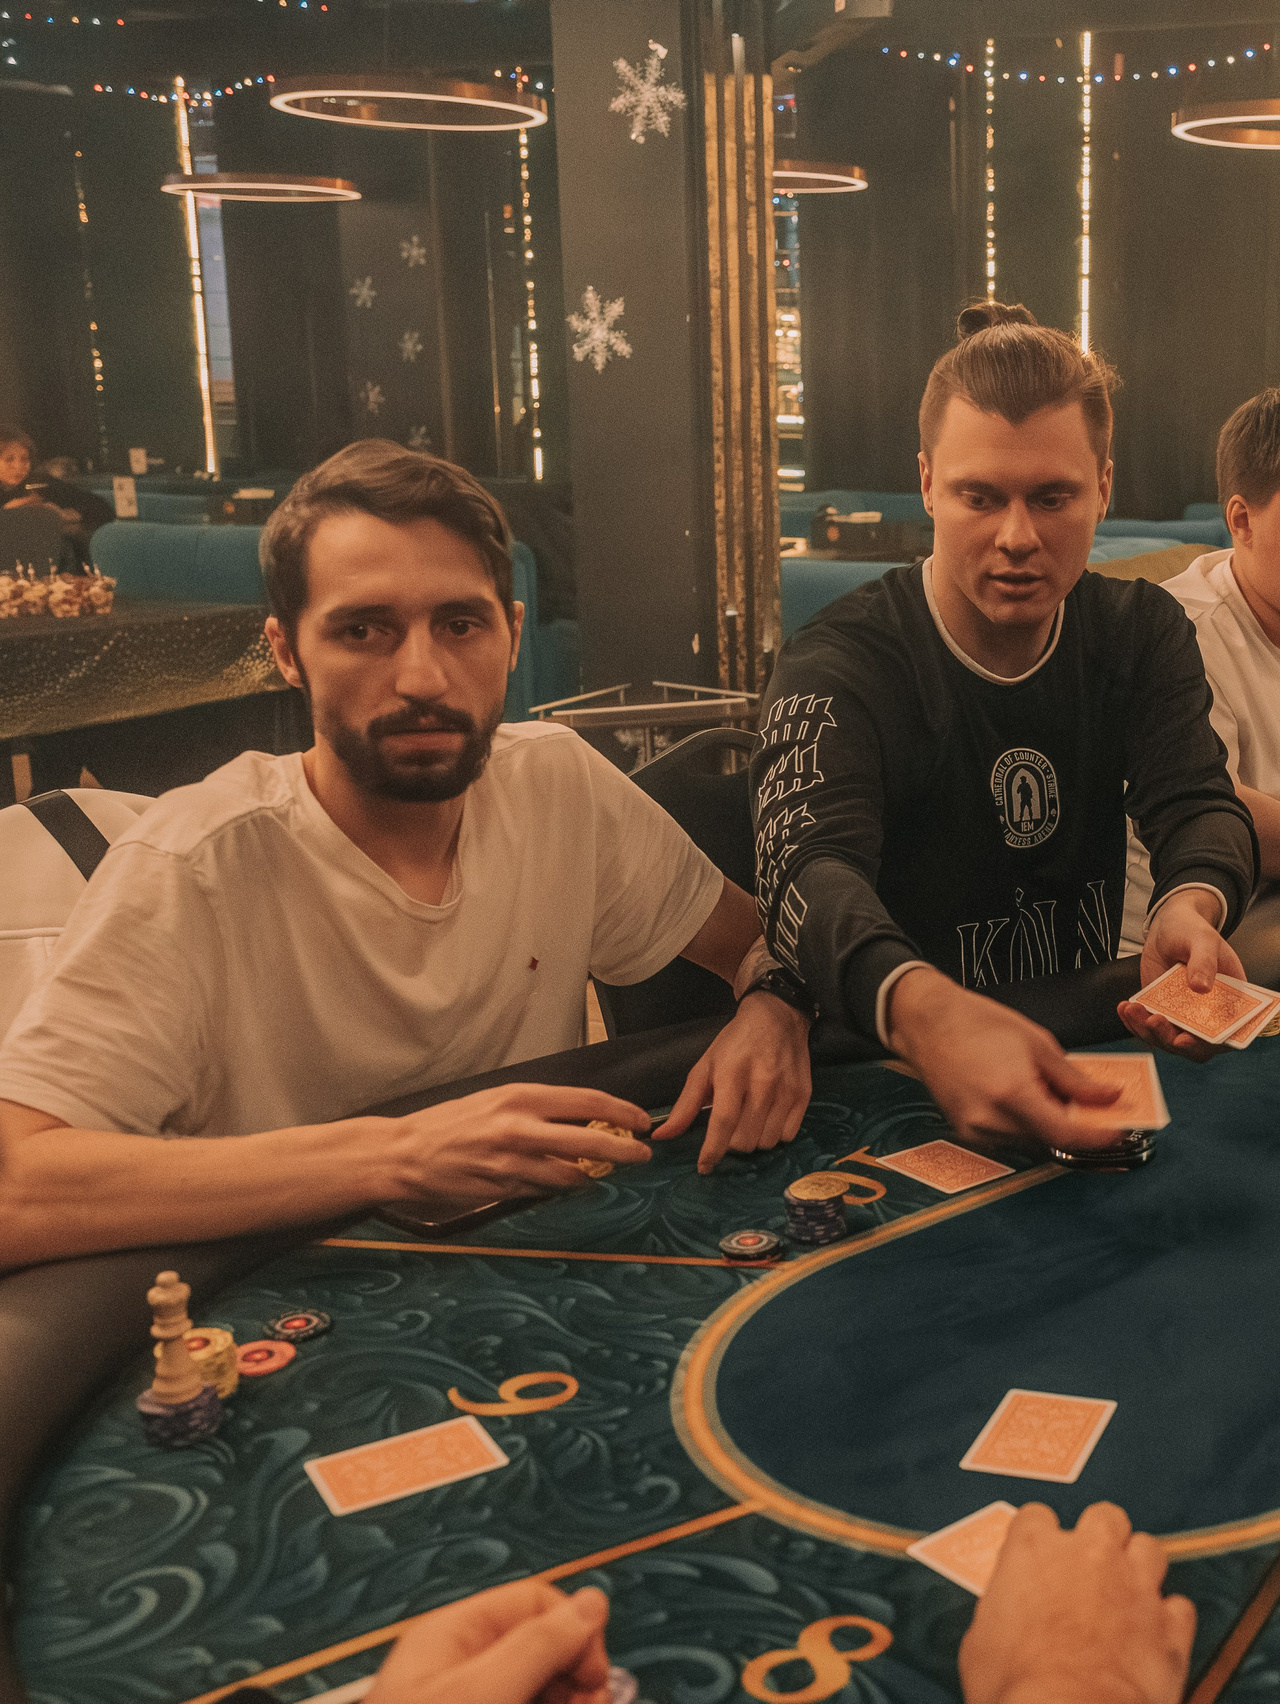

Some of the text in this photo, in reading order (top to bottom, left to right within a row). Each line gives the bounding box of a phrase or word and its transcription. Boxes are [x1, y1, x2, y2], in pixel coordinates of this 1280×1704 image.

[994, 763, 1008, 806] CATHEDRAL
[1004, 755, 1014, 767] OF
[1021, 821, 1034, 832] IEM
[741, 1614, 894, 1704] 8
